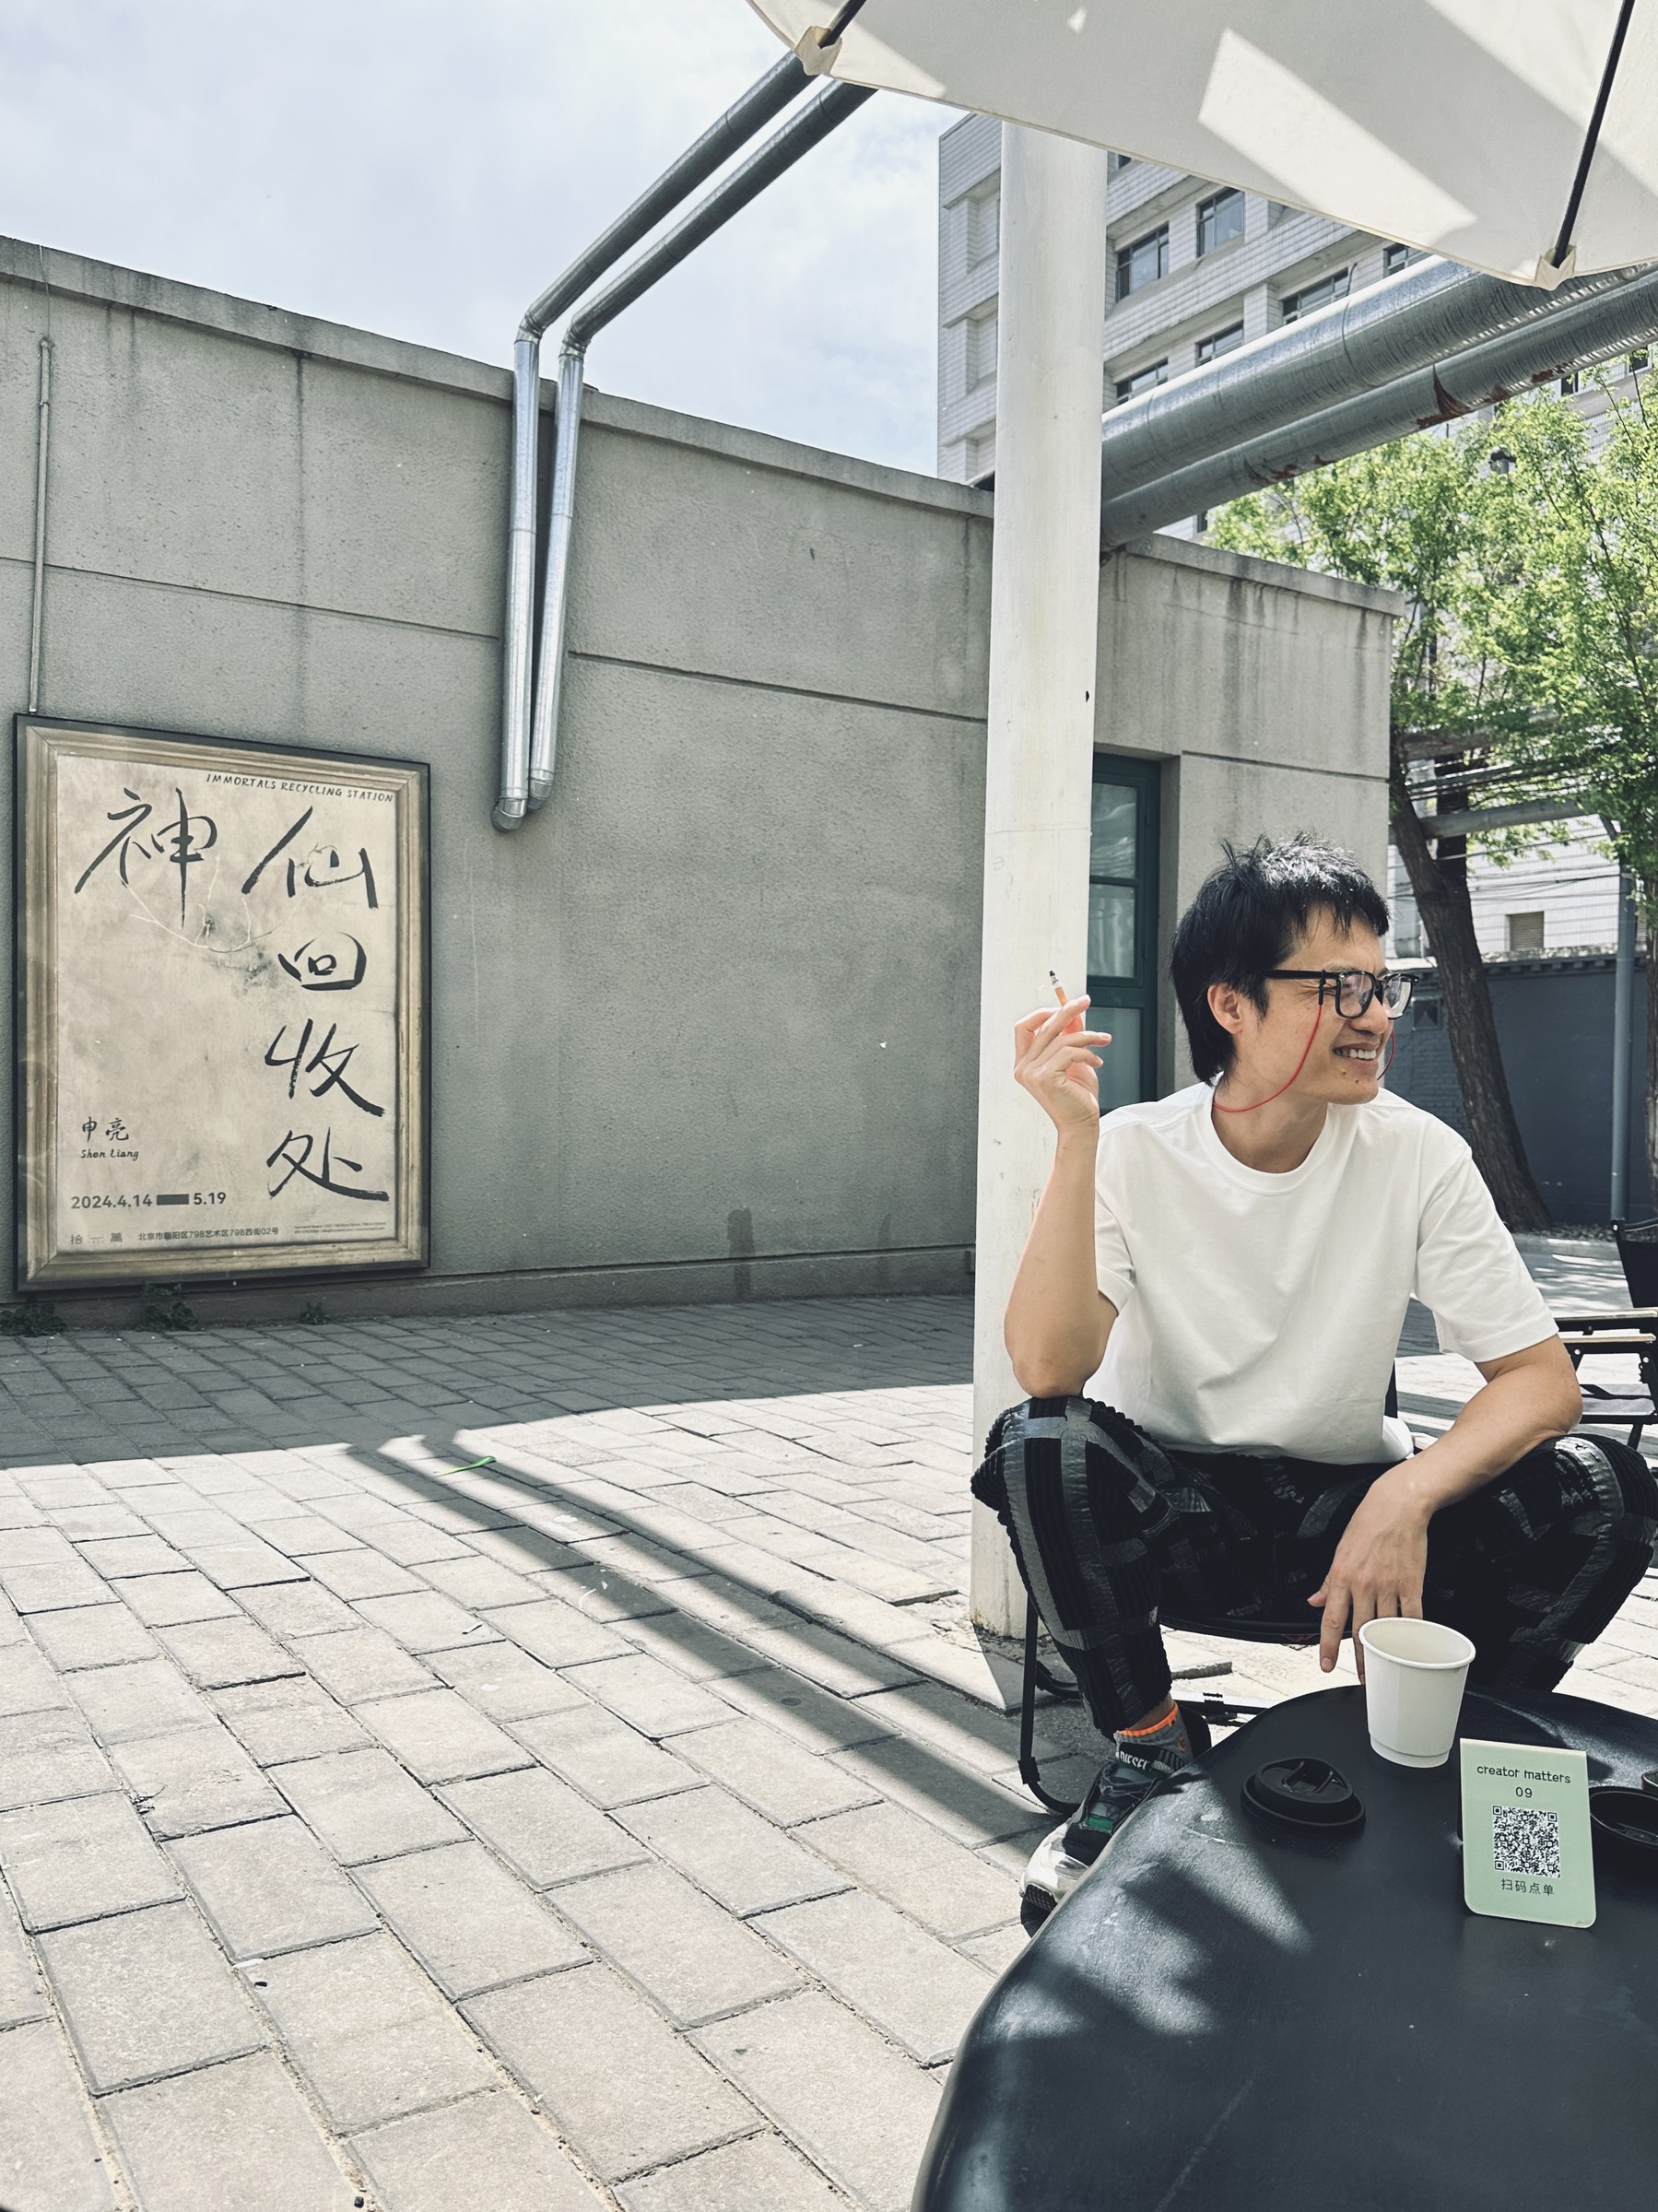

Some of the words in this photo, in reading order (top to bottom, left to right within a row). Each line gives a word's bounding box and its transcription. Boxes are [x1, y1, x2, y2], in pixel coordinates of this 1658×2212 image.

[206, 773, 276, 790] IMMORTALS
[280, 782, 342, 797] RECYCLING
[347, 789, 394, 803] STATION
[81, 1116, 129, 1142] 申亮
[110, 1148, 139, 1161] Liang
[70, 1194, 153, 1209] 2024.4.14
[193, 1192, 227, 1205] 5.19
[1476, 1764, 1521, 1778] creator
[1523, 1770, 1571, 1783] matters
[1515, 1786, 1534, 1798] 09
[1500, 1877, 1555, 1896] 扫码点单
